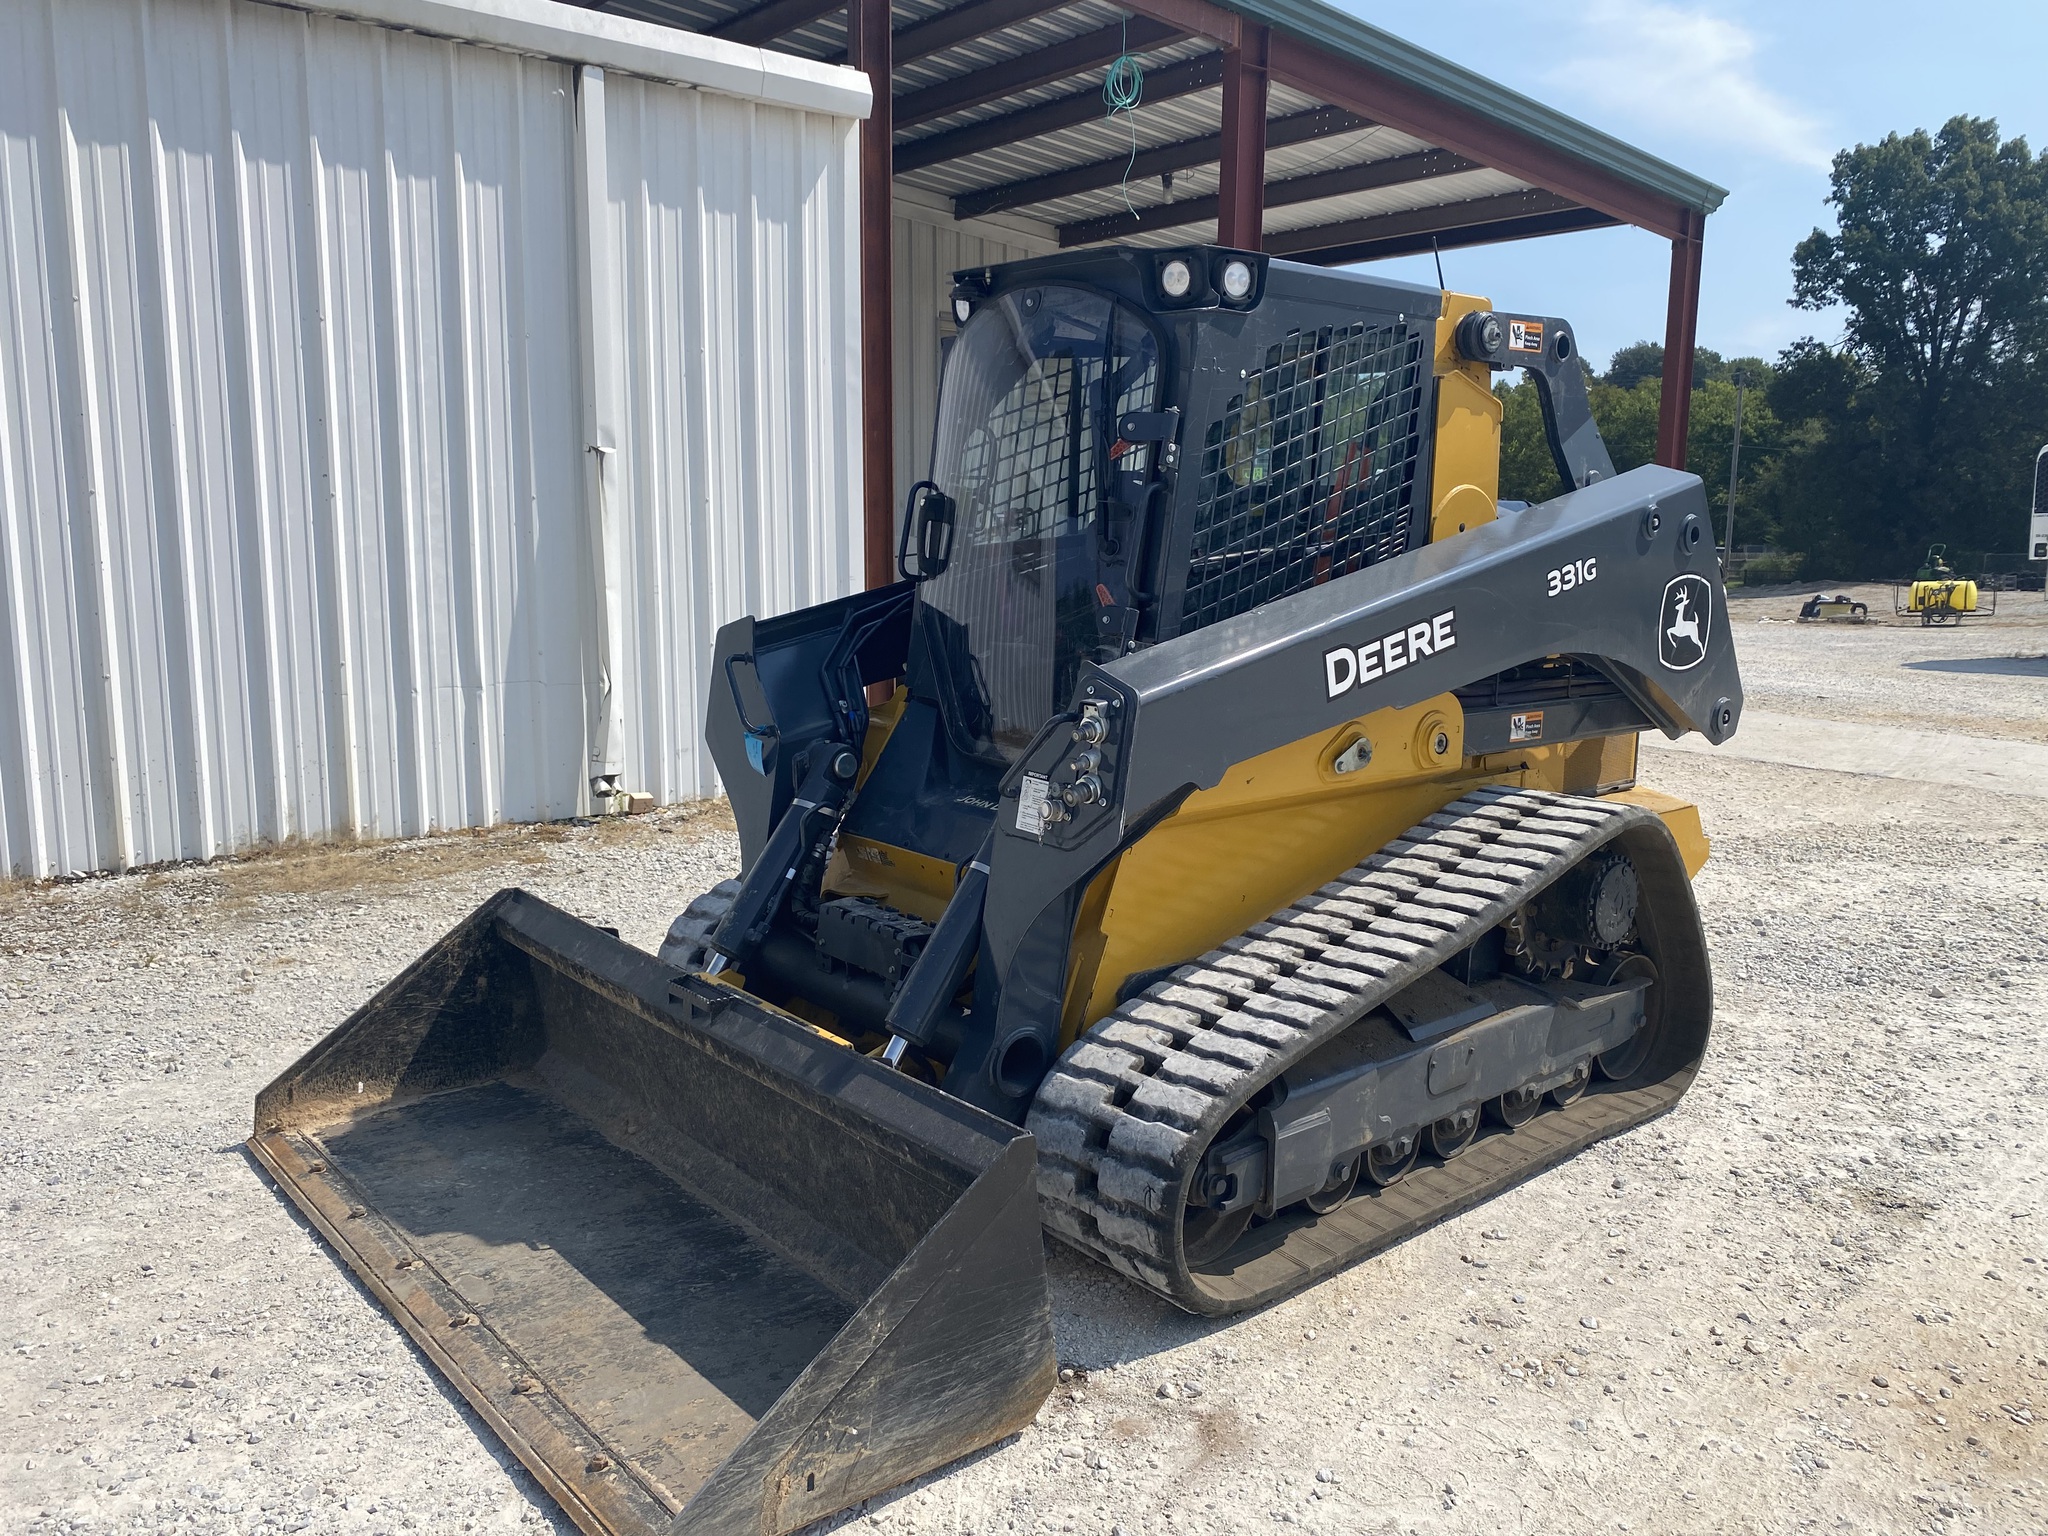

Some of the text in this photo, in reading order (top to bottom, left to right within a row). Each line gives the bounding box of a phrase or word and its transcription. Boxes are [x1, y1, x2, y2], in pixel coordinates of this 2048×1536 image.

[1547, 557, 1597, 597] 331G
[1325, 610, 1456, 698] DEERE
[954, 795, 994, 808] JOHN
